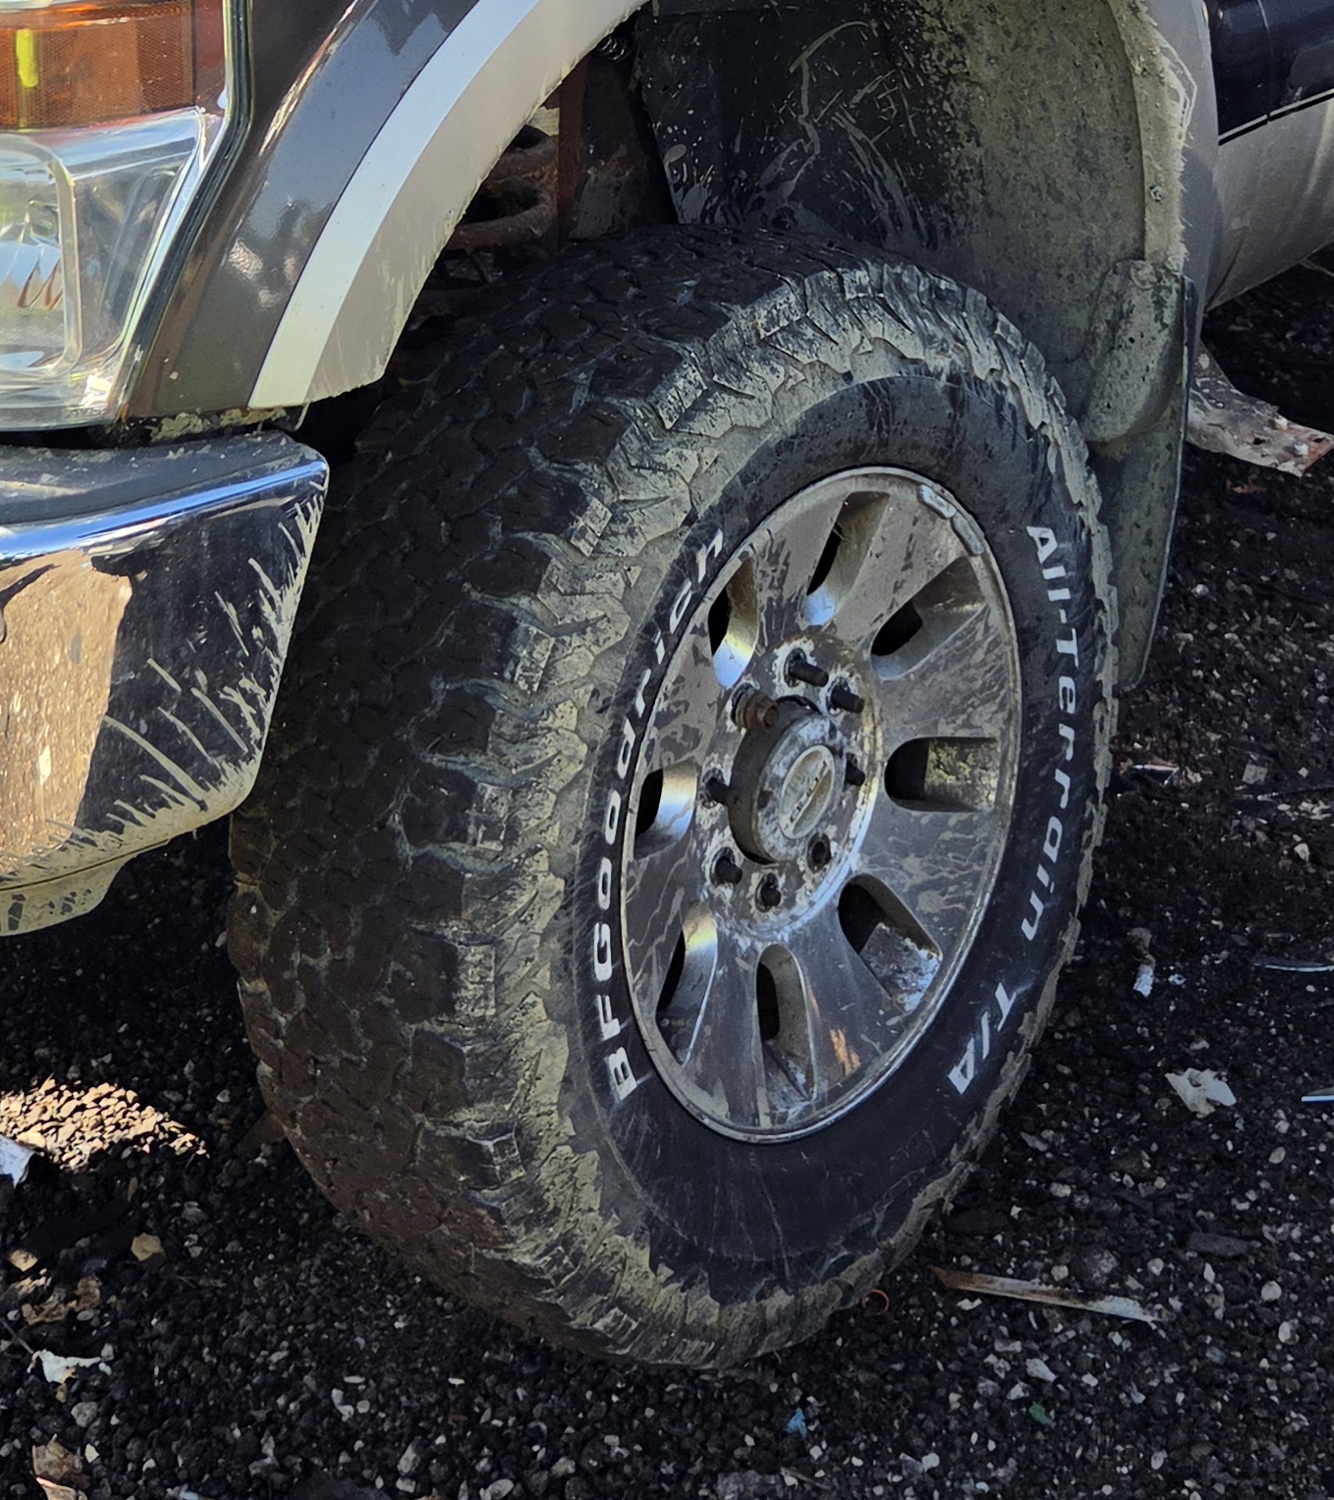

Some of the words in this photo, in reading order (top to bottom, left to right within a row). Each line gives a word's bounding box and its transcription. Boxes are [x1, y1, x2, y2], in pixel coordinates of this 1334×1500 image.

[593, 528, 723, 1101] BFGoodrich
[1021, 526, 1079, 941] All-Terrain
[947, 982, 1016, 1095] T/A
